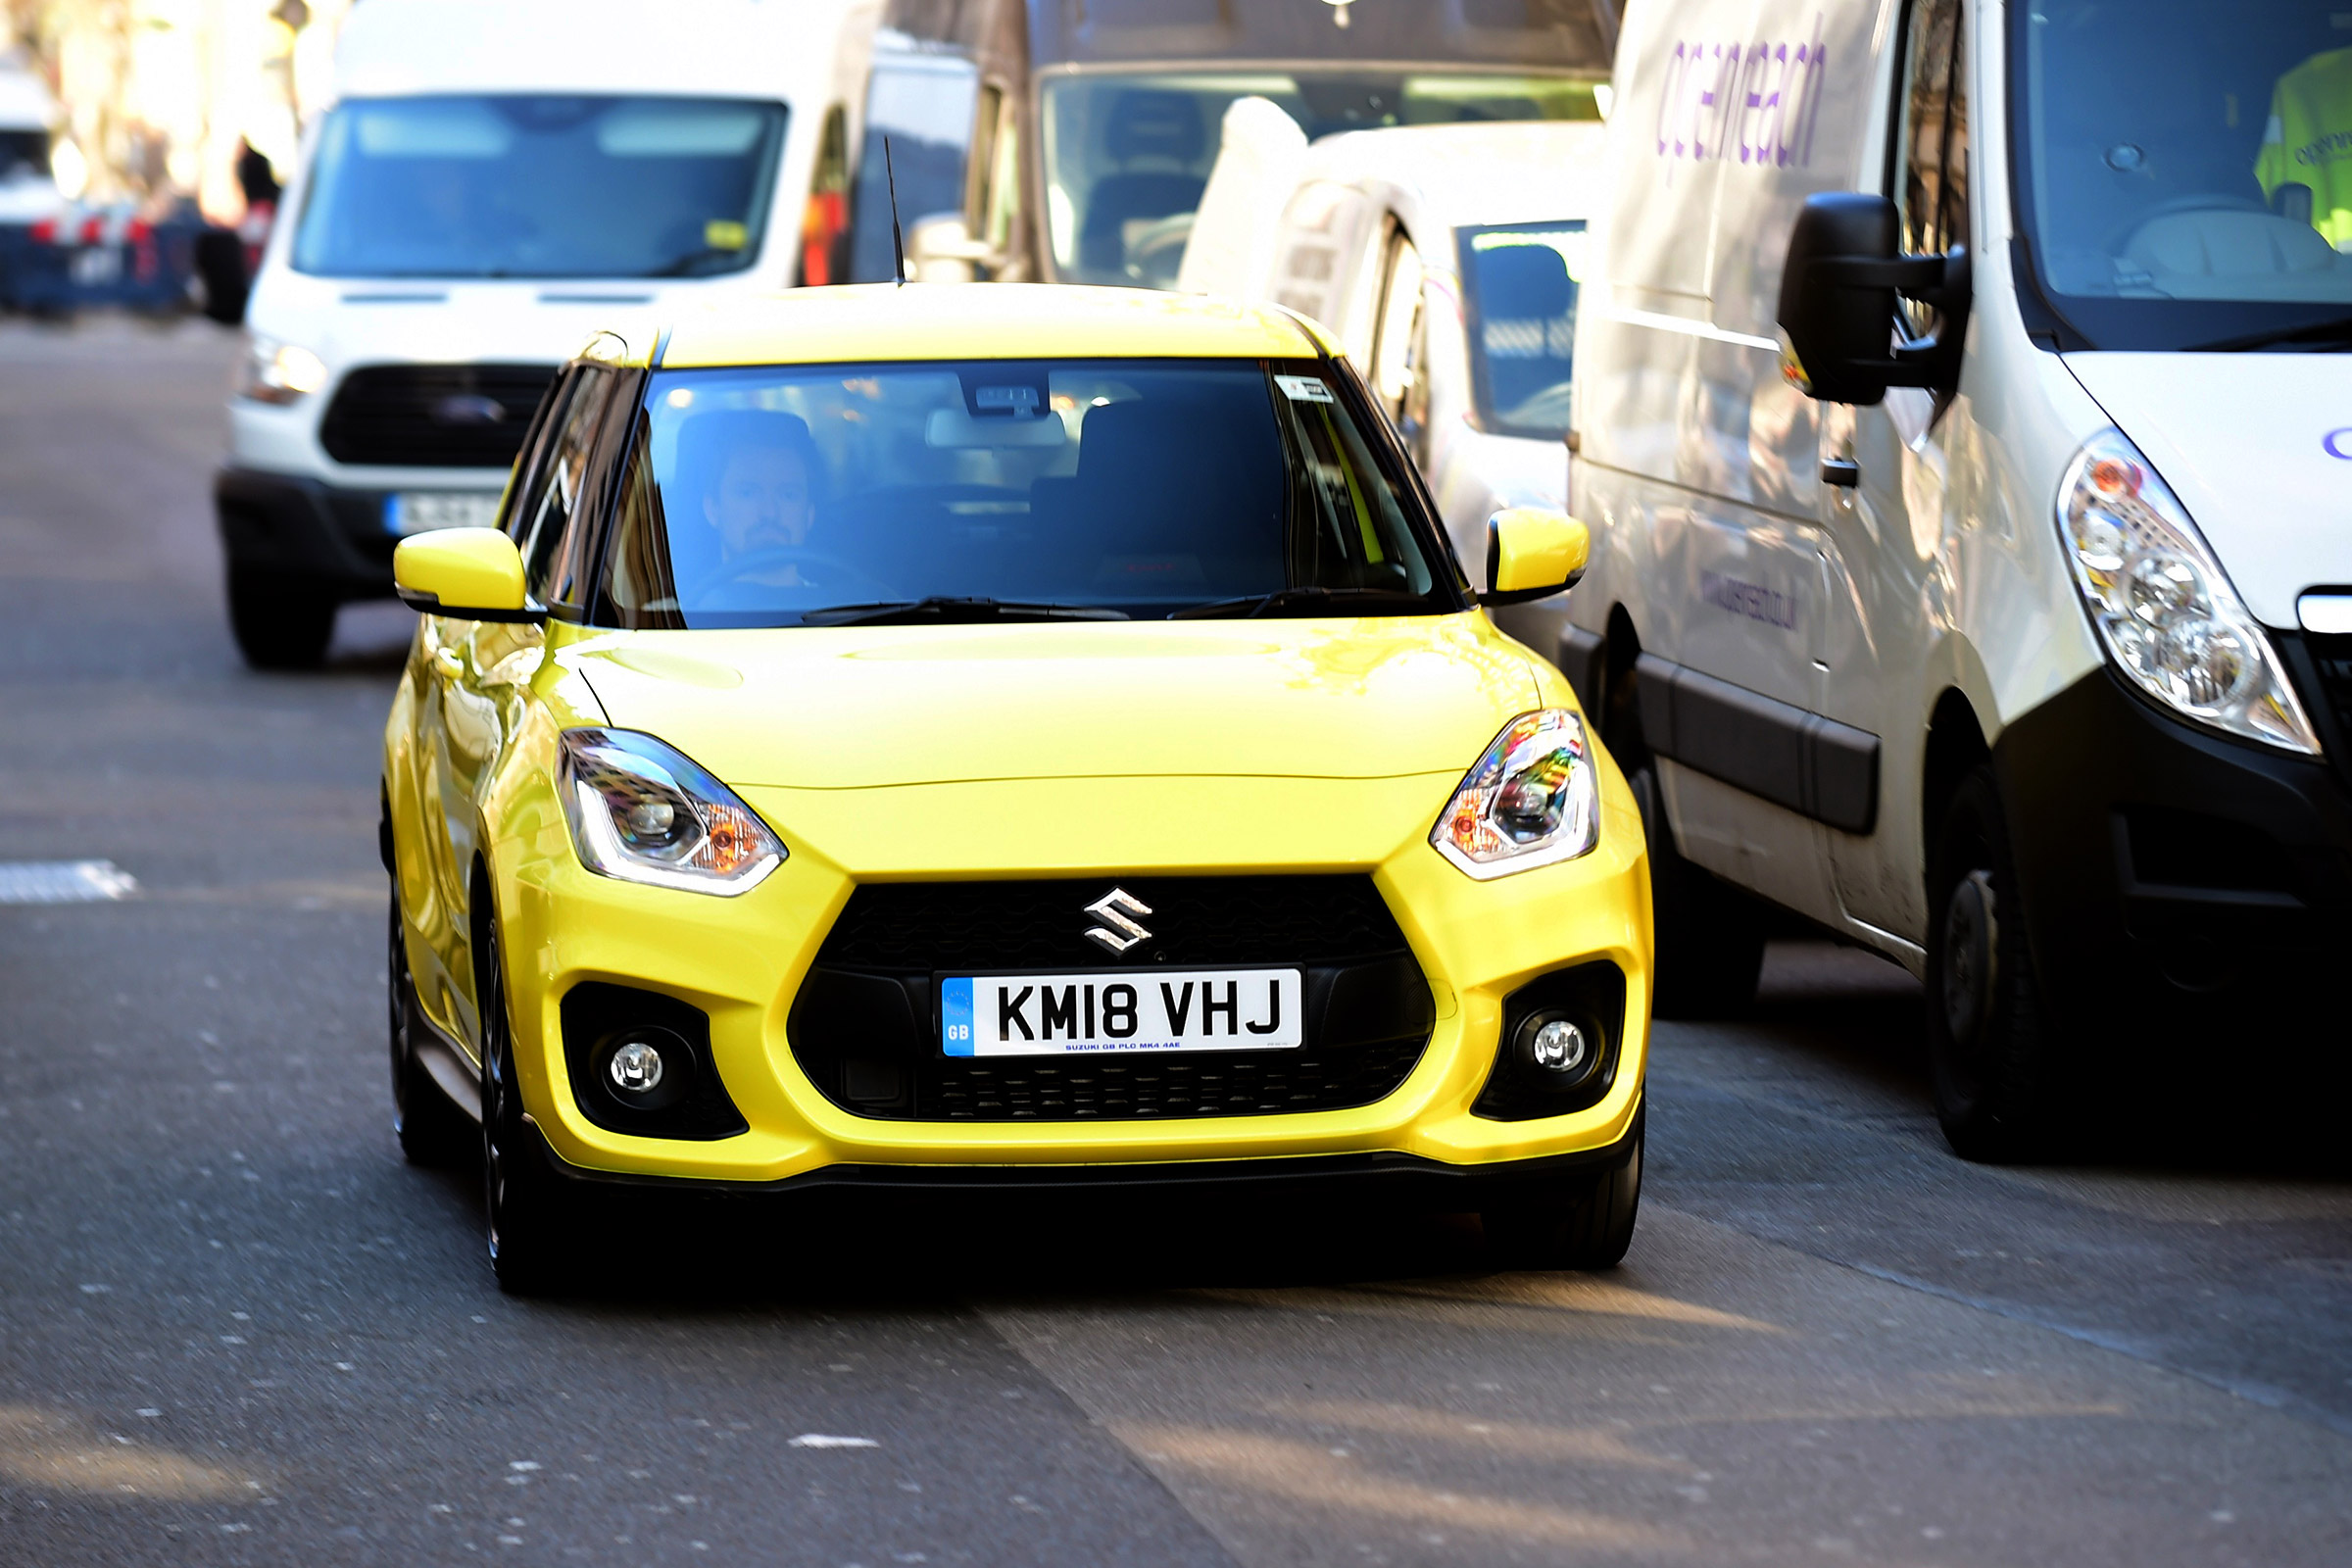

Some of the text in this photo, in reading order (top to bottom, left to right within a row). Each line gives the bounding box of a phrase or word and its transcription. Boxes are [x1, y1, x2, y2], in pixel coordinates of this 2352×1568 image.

[1657, 11, 1827, 189] openreach
[948, 1024, 969, 1041] GB
[998, 979, 1281, 1041] KM18 VHJ
